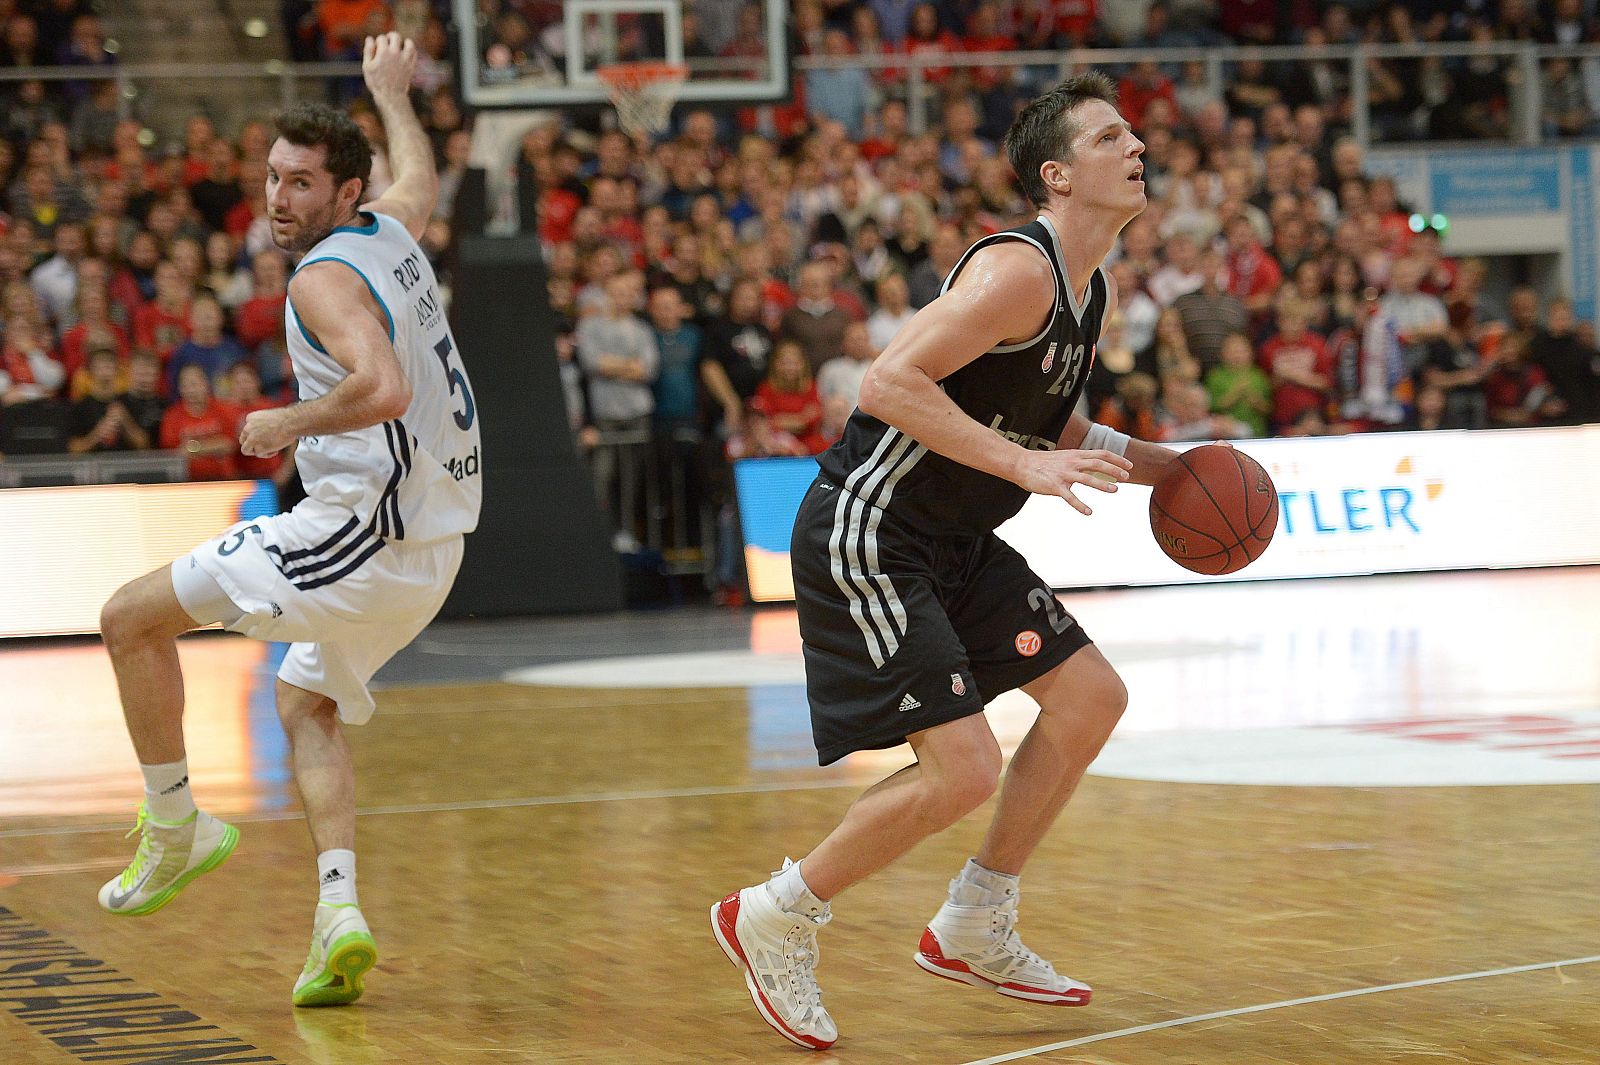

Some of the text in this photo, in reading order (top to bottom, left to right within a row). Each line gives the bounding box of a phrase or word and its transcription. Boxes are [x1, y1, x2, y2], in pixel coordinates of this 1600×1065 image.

[433, 333, 474, 431] 5
[1046, 344, 1084, 397] 23
[217, 525, 262, 557] 5
[1028, 583, 1074, 635] 2
